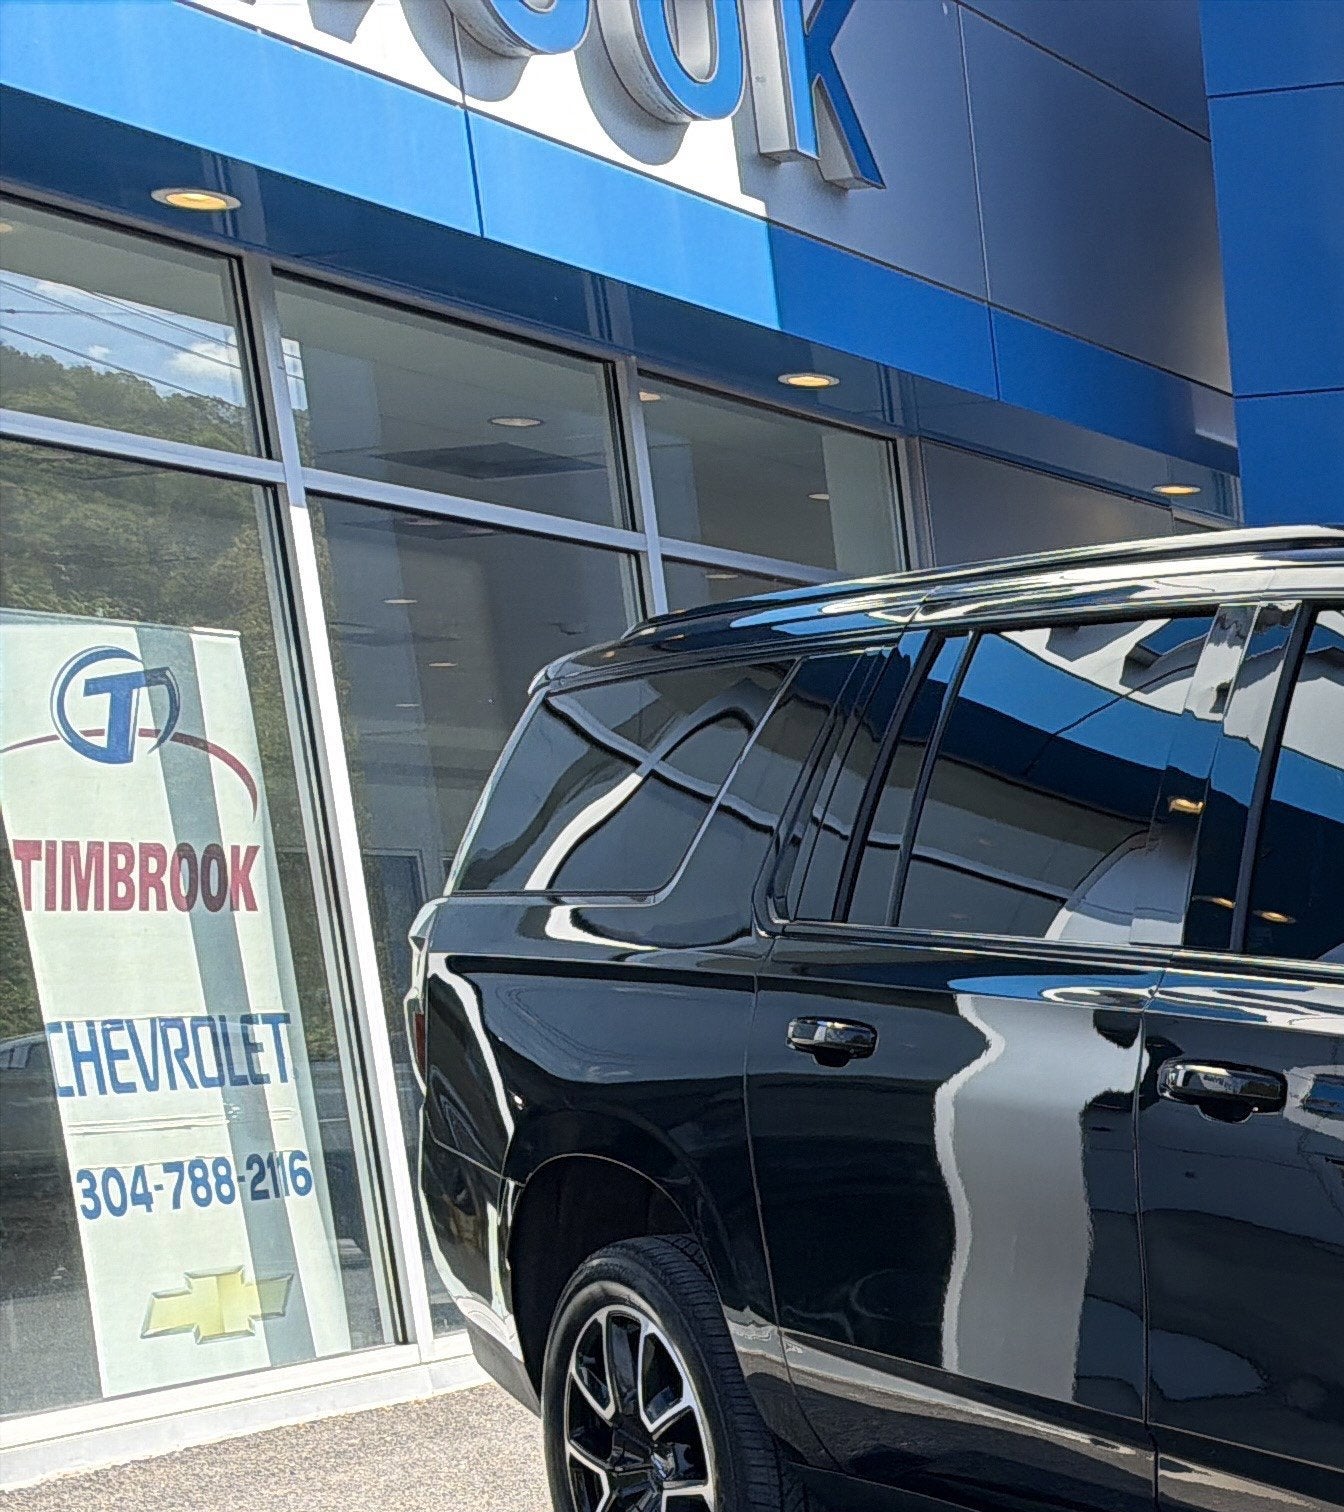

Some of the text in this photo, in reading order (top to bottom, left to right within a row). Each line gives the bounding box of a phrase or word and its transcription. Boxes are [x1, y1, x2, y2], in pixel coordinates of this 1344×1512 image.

[12, 838, 261, 912] TIMBROOK
[45, 1012, 291, 1098] CHEVROLET
[76, 1149, 313, 1220] 304-788-2116
